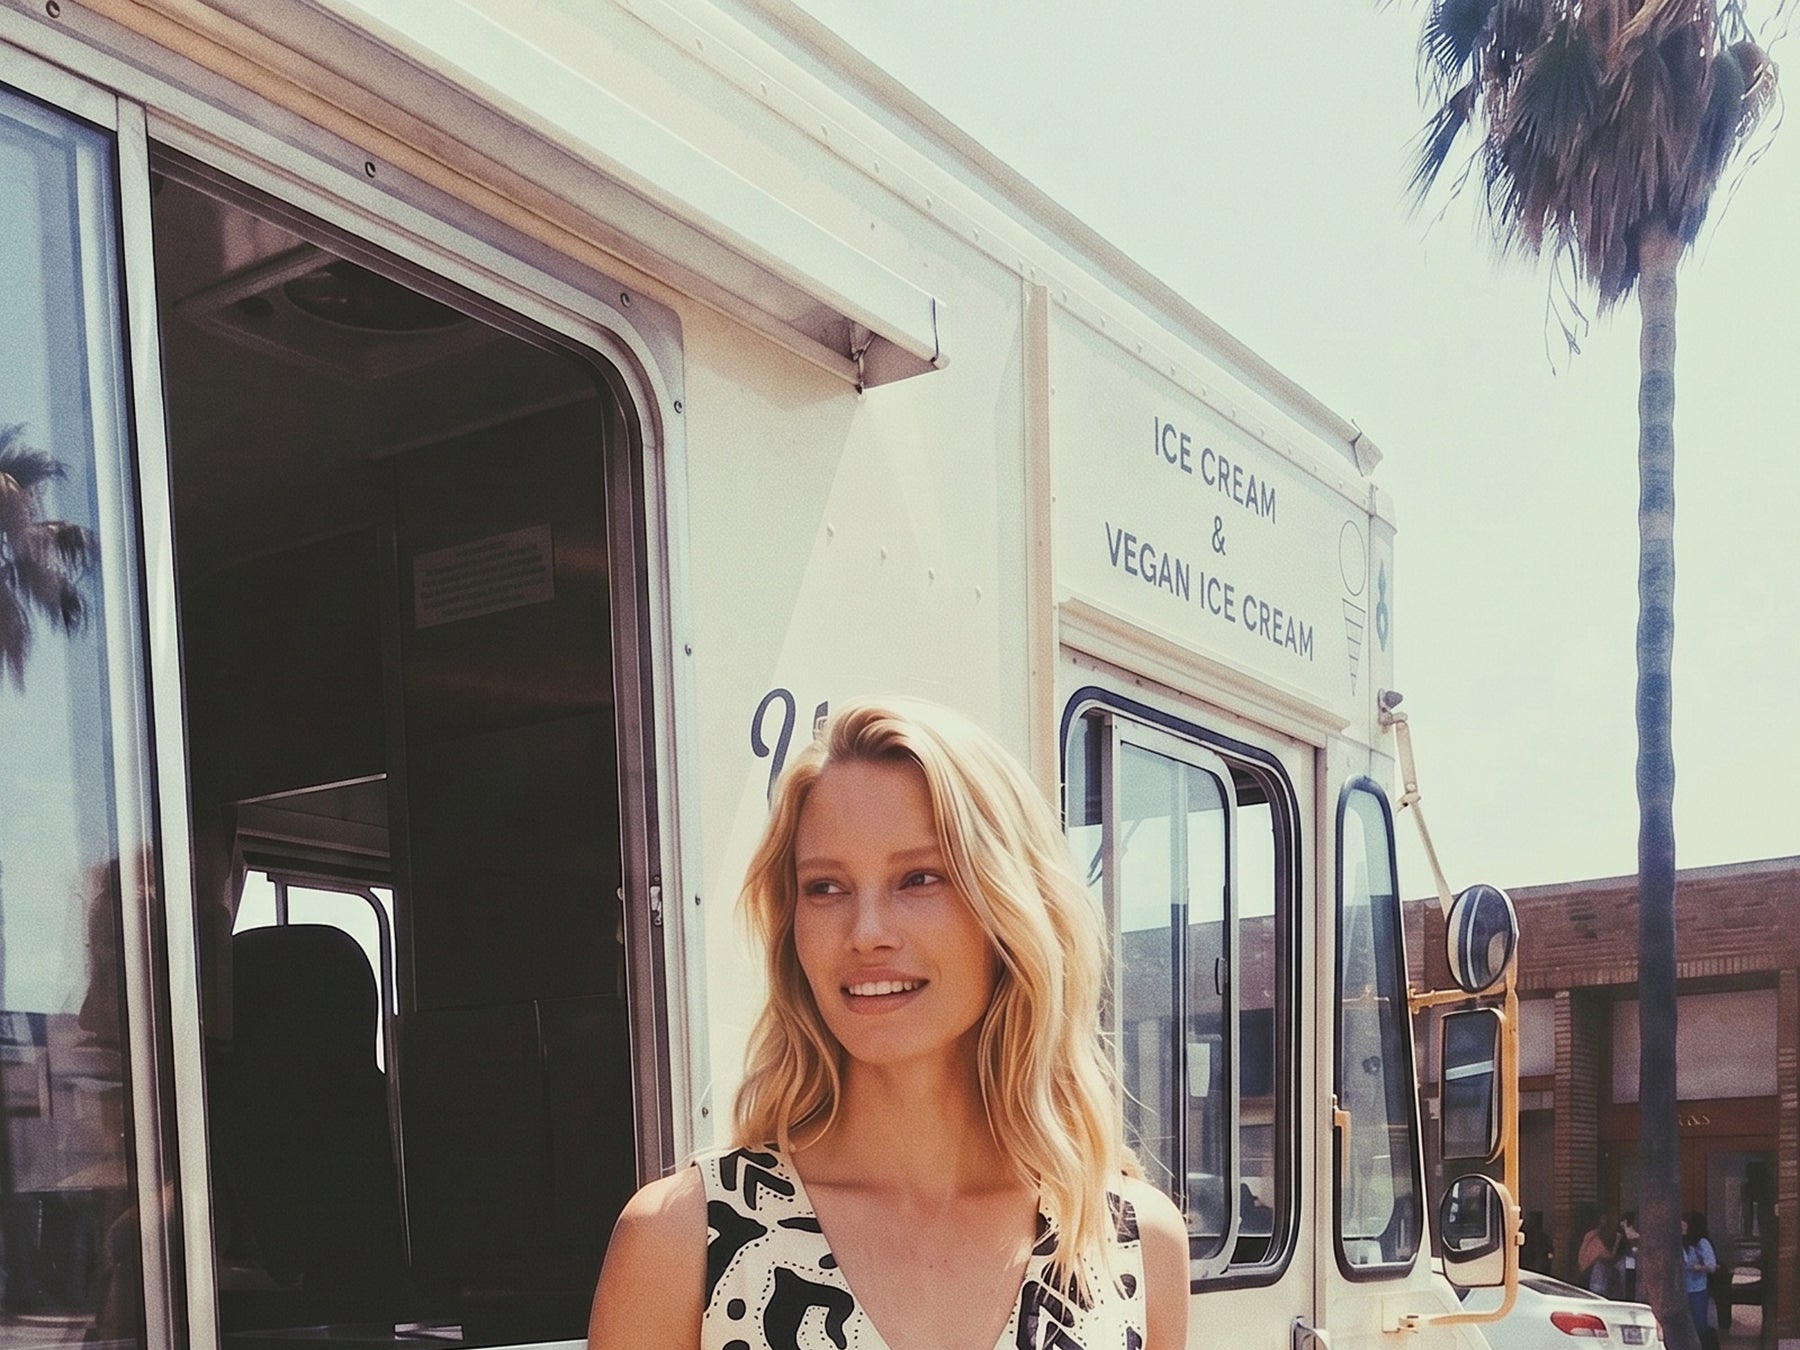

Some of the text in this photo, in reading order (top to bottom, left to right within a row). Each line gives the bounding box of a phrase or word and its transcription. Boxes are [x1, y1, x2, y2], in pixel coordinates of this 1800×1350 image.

[1154, 416, 1276, 525] ICE CREAM
[1211, 515, 1226, 556] &
[1105, 521, 1314, 662] VEGAN ICE CREAM
